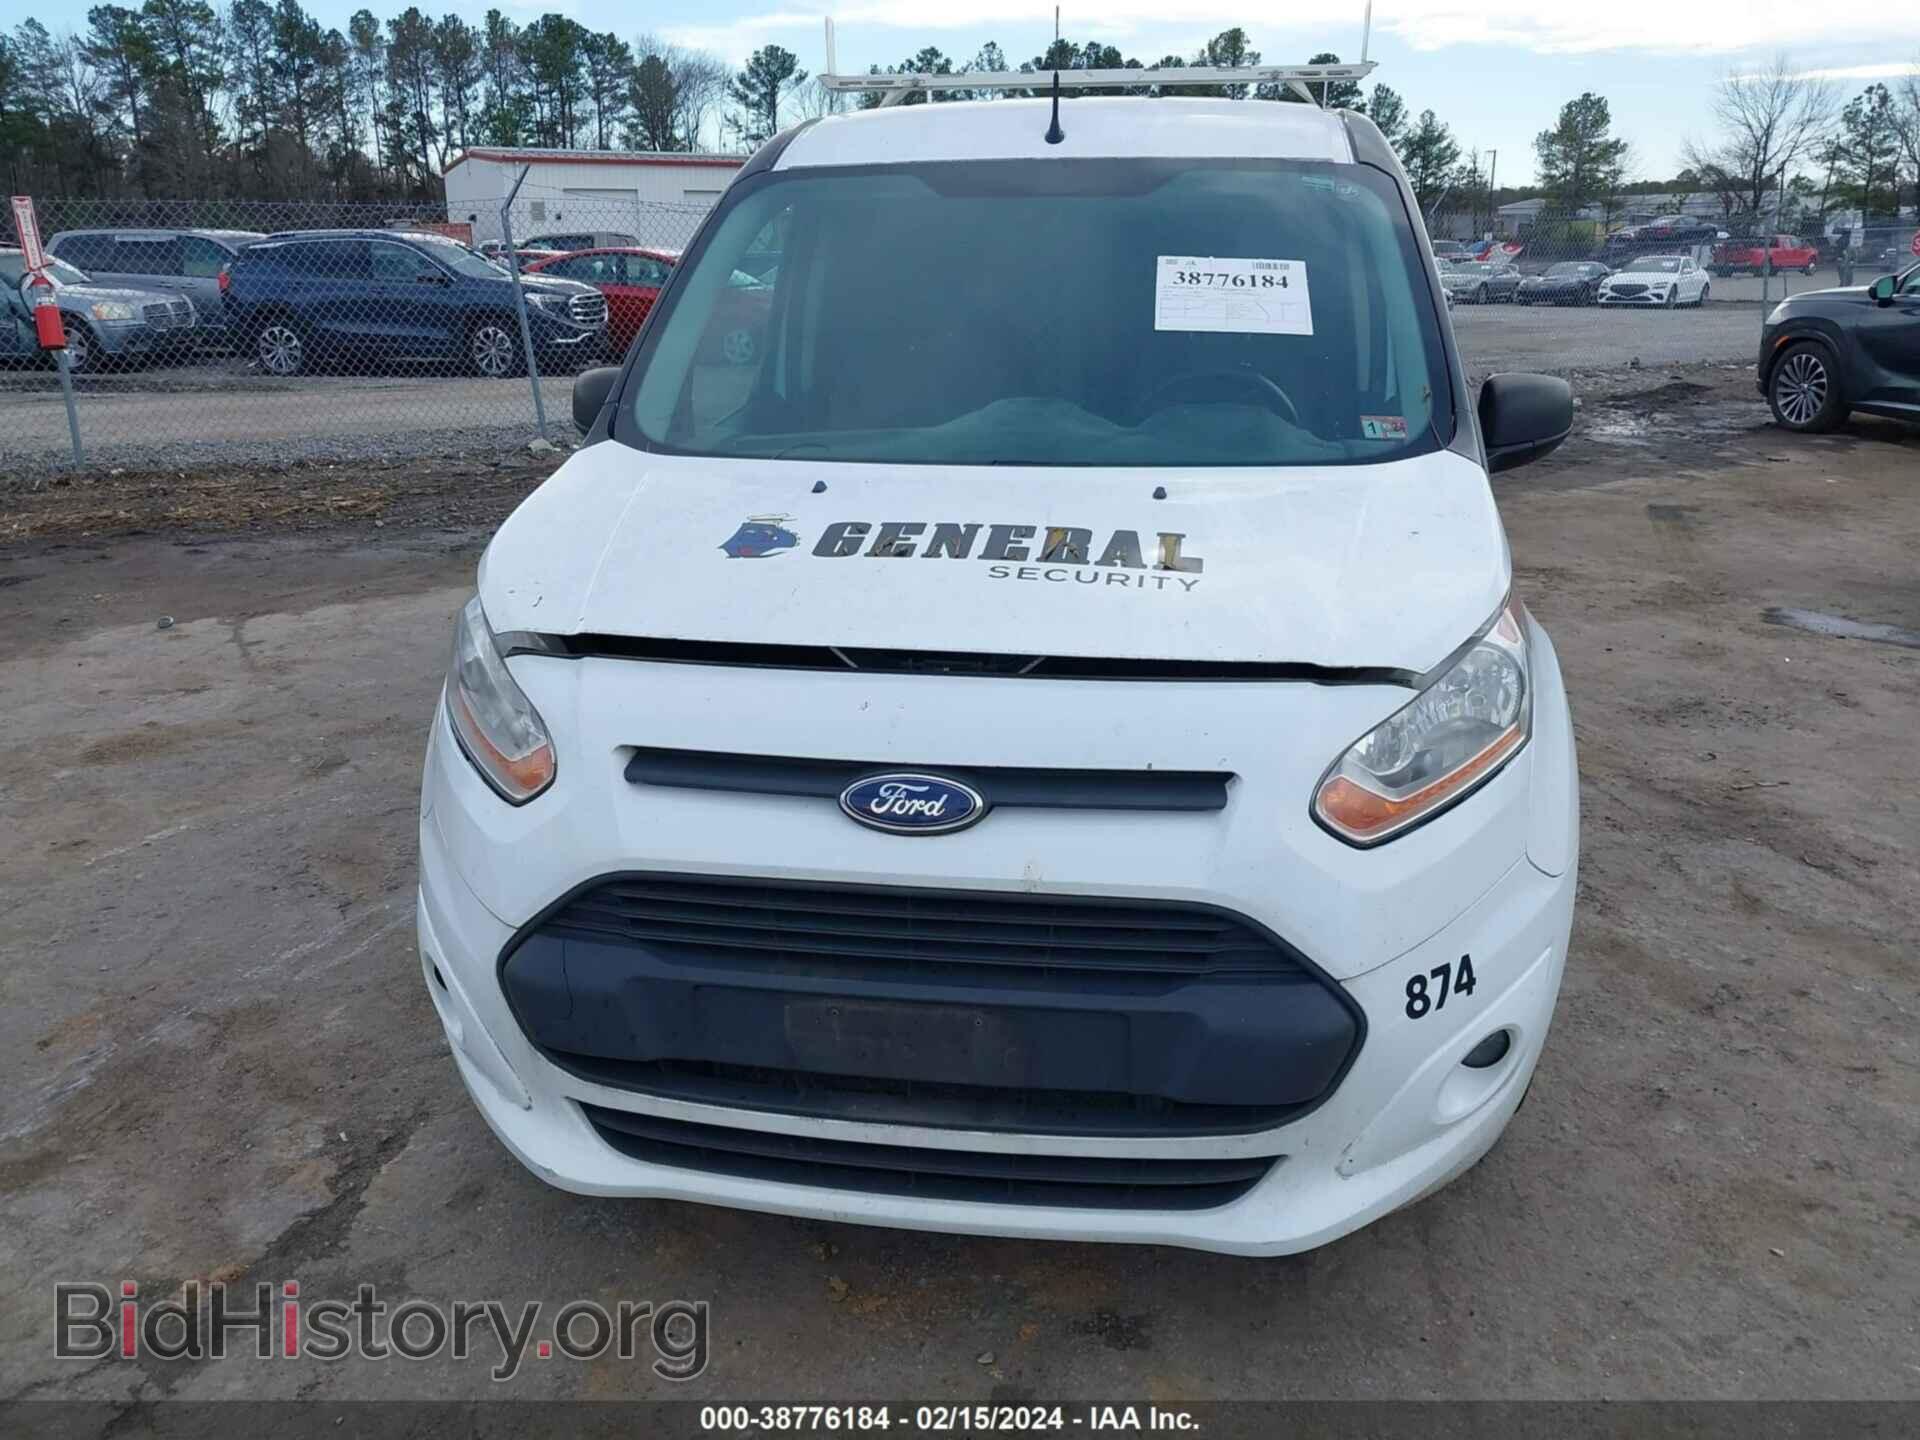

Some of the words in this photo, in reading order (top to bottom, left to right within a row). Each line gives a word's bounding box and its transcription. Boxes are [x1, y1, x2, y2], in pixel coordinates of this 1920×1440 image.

[1173, 271, 1288, 289] 38776184
[812, 521, 1203, 573] GENERAL
[988, 566, 1200, 592] SECURITY
[870, 782, 946, 816] Ford
[1405, 953, 1477, 1020] 874
